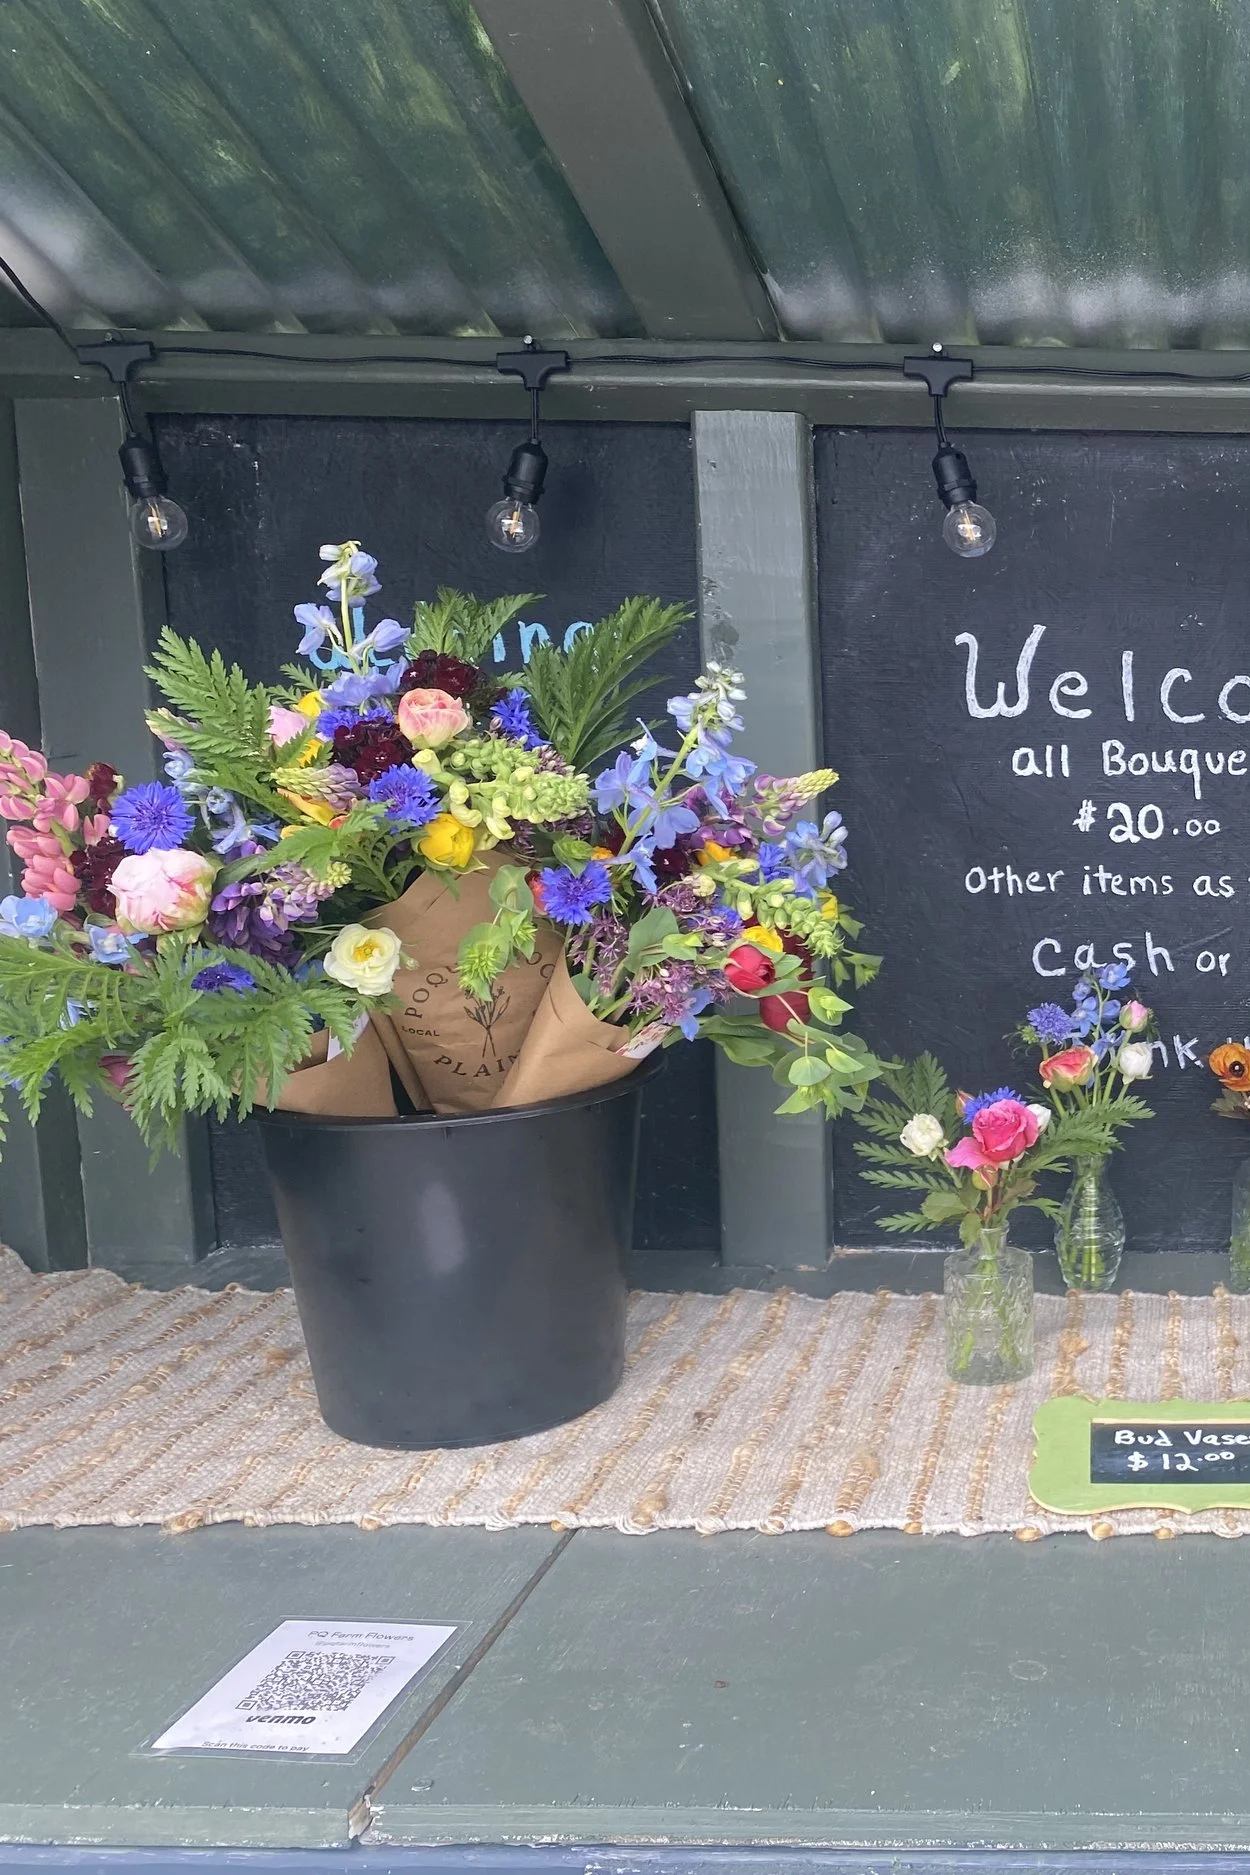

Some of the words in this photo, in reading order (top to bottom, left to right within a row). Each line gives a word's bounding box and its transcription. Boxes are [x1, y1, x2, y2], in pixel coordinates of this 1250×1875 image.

[1012, 744, 1071, 779] all
[1083, 864, 1175, 897] items
[1193, 876, 1238, 900] as
[1032, 931, 1175, 977] Cash
[1196, 951, 1233, 977] or
[1114, 1429, 1174, 1448] Bud
[330, 1631, 363, 1639] Farm
[364, 1632, 415, 1641] Flowers
[245, 1715, 317, 1725] venmo
[201, 1740, 227, 1748] Scan
[229, 1741, 248, 1749] this
